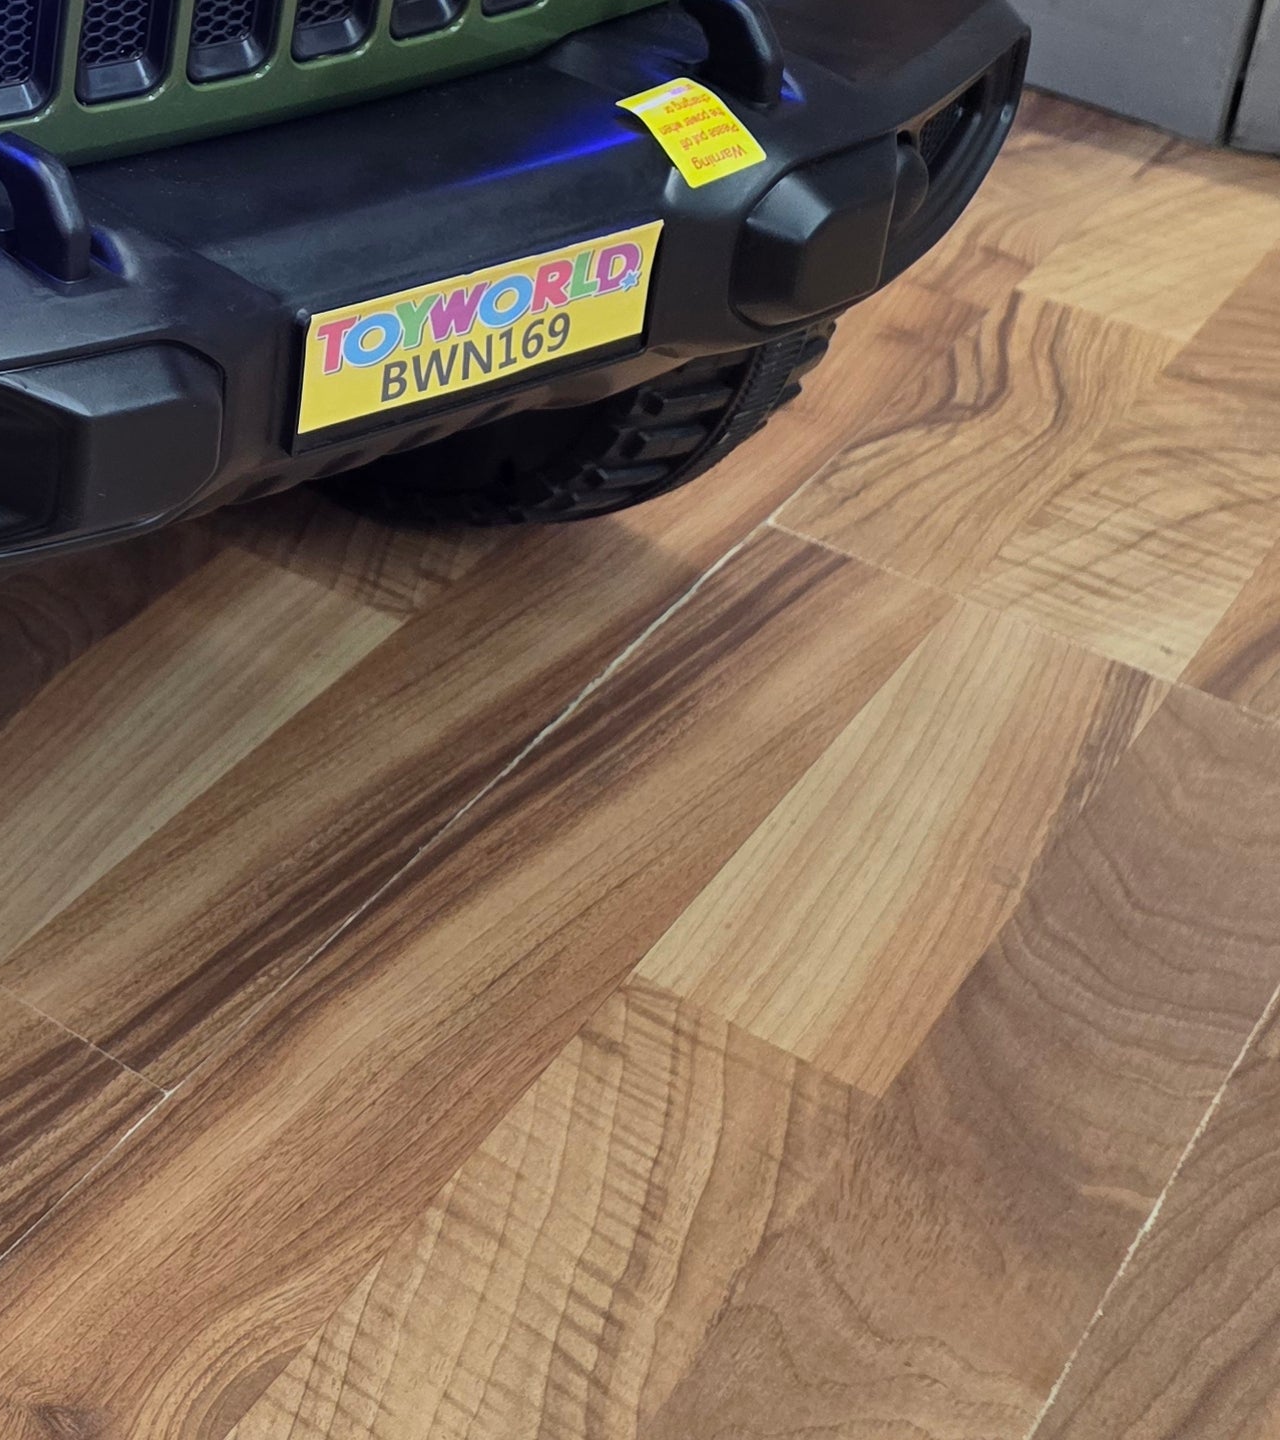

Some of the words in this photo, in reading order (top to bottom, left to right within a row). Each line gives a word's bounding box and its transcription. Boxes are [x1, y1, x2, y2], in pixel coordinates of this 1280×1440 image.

[691, 144, 747, 171] Warning
[317, 242, 643, 375] TOYWORLD
[380, 312, 571, 403] BWN169
